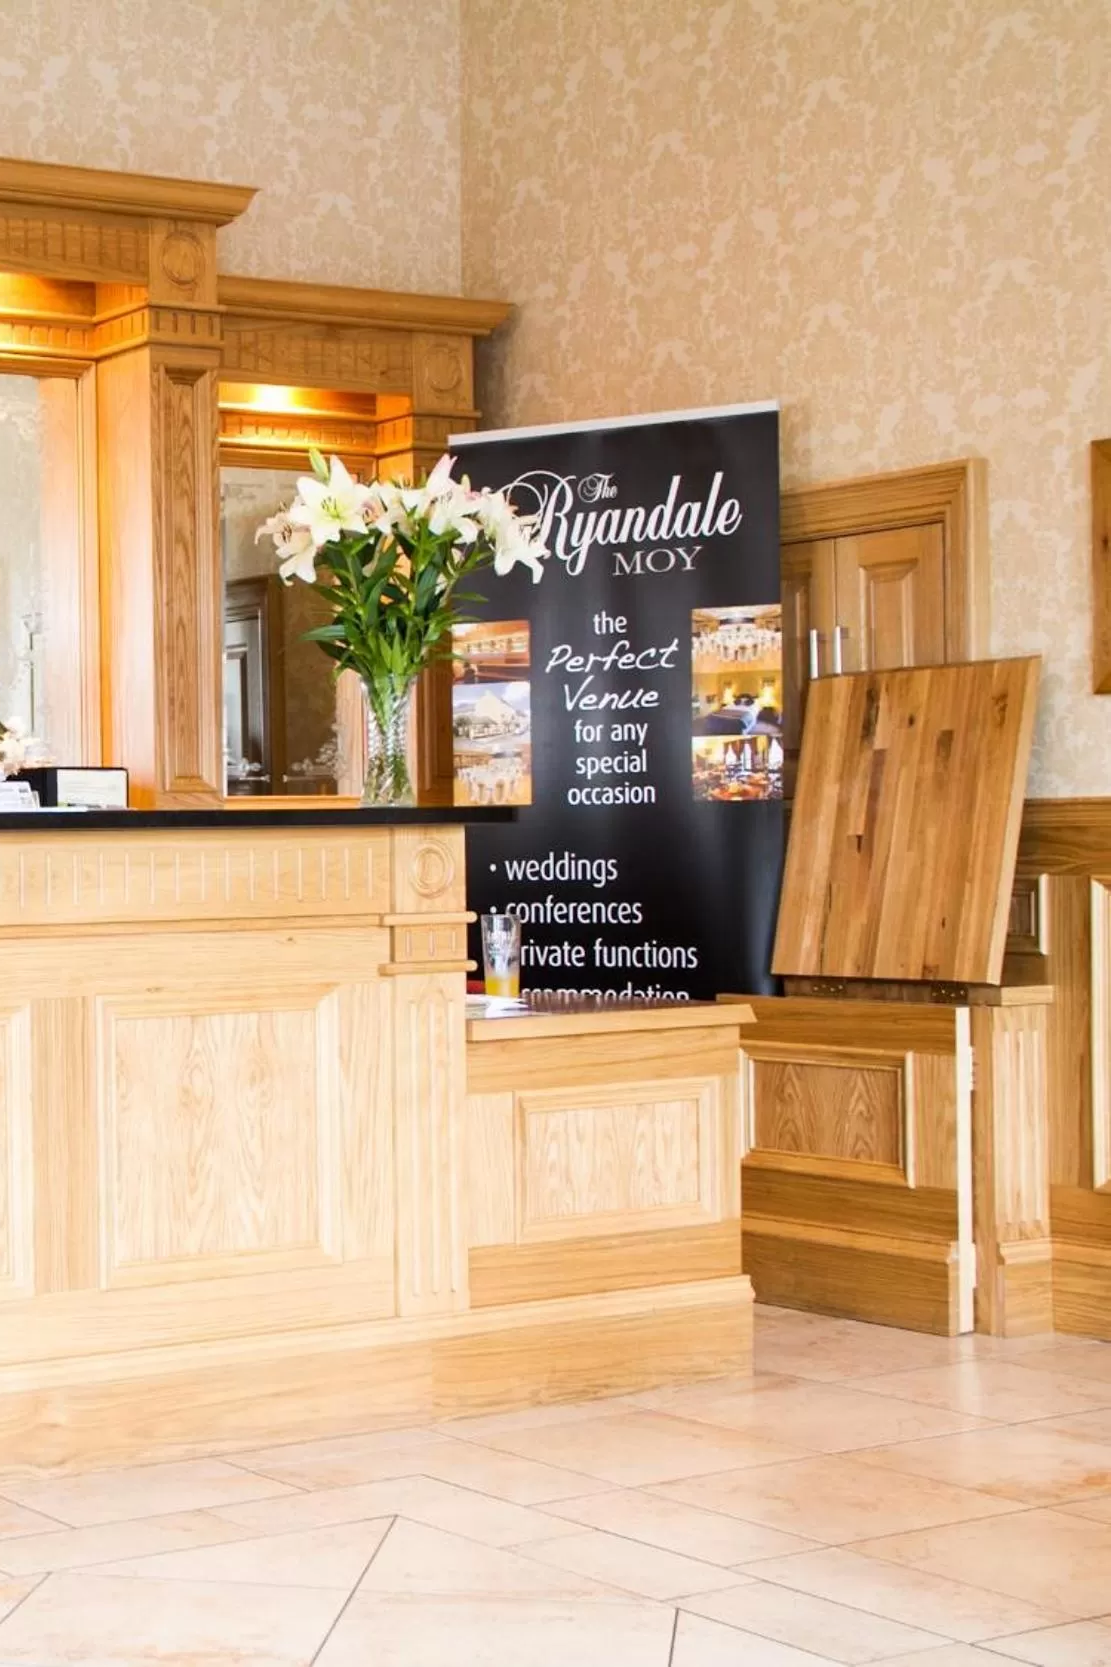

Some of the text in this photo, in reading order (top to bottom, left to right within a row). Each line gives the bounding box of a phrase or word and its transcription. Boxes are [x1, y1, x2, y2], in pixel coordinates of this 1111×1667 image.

[577, 473, 618, 503] The
[498, 470, 743, 577] Ryandale
[612, 545, 702, 576] MOY
[593, 611, 627, 635] the
[545, 638, 679, 674] Perfect
[563, 675, 660, 712] Venue
[575, 720, 648, 746] for any
[575, 749, 647, 780] special
[567, 782, 656, 805] occasion
[505, 852, 618, 888] weddings
[505, 895, 643, 924] conferences
[520, 938, 698, 969] rivate functions
